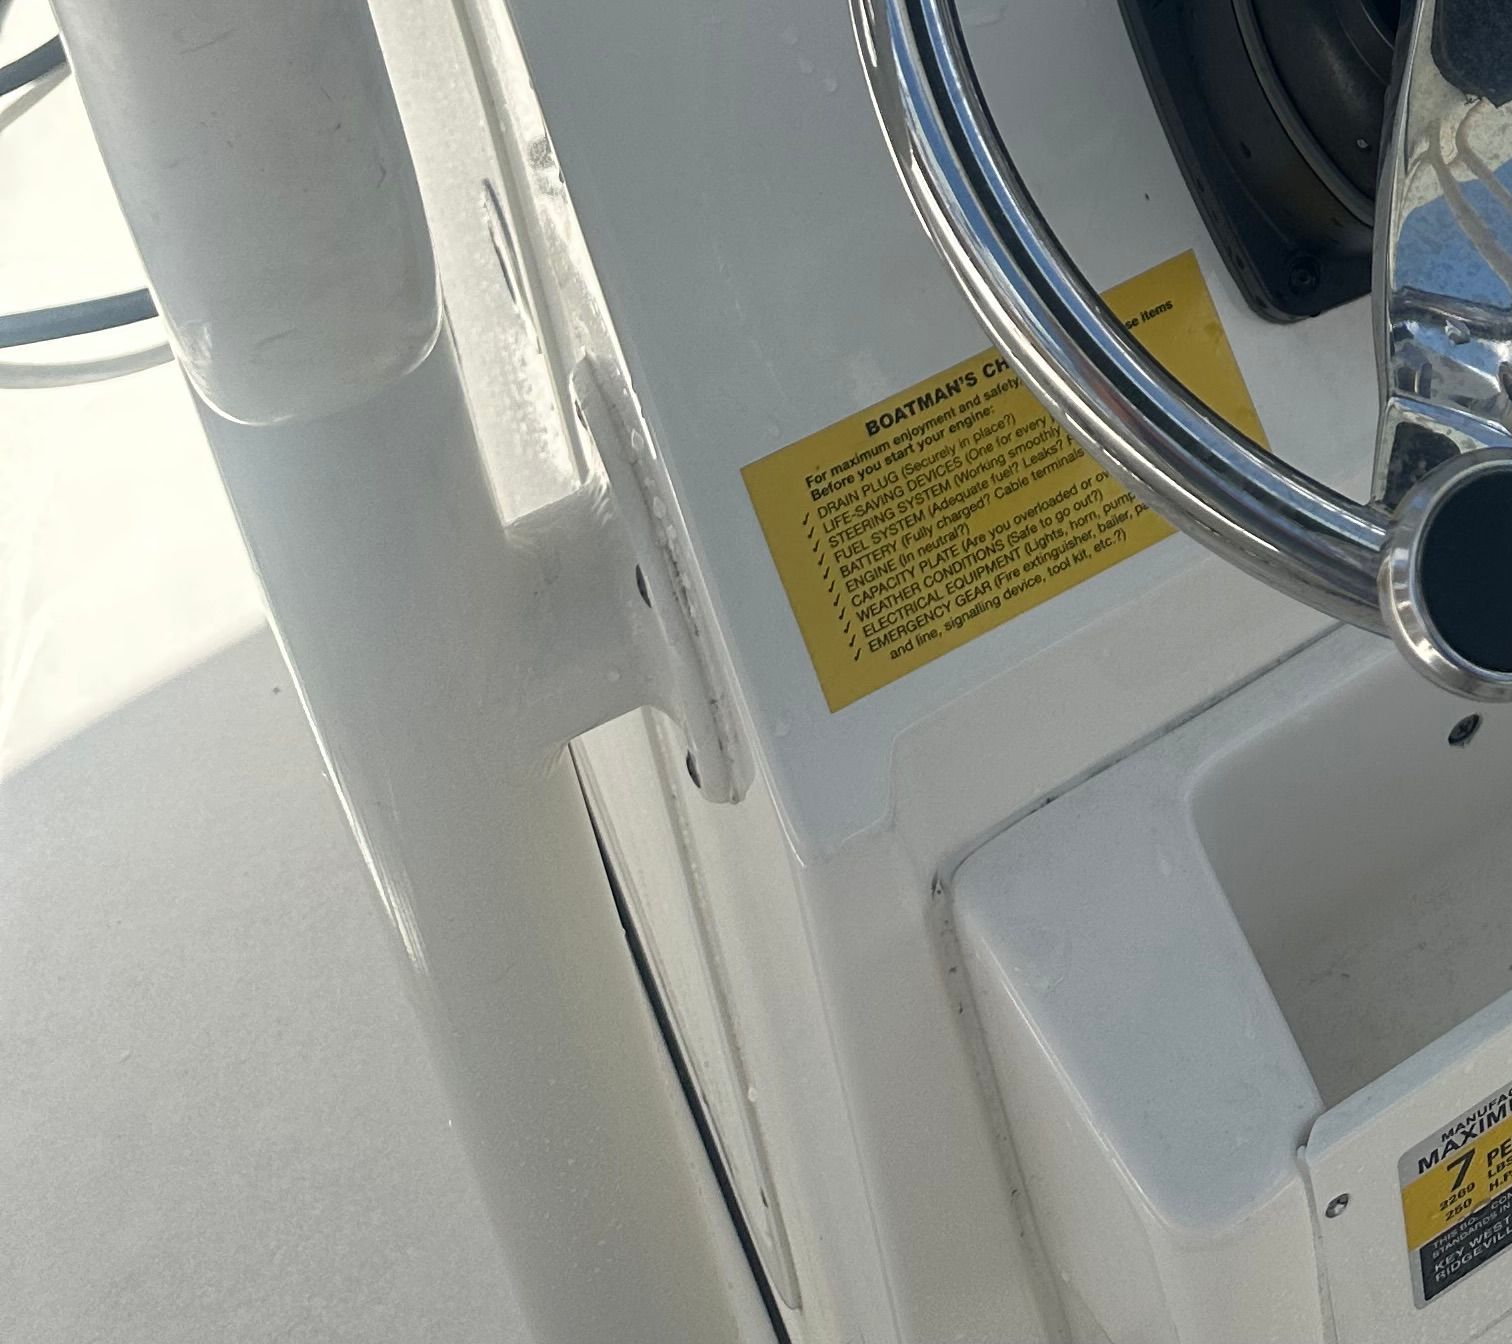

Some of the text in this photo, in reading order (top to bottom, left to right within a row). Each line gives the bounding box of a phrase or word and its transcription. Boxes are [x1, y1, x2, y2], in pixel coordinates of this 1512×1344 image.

[804, 470, 826, 488] For
[829, 440, 891, 477] maximum
[891, 406, 957, 445] enjoyment
[957, 393, 981, 414] and
[1139, 300, 1173, 322] items
[864, 371, 978, 436] BOATMAN'S
[809, 404, 994, 502] Before you start your engine:
[816, 412, 1016, 519] DRAIN PLUG (Securely in place?)
[821, 415, 1046, 534] LIFE-SAVING DEVICES (One for every
[827, 506, 896, 549] STEERING
[896, 478, 952, 514] SYSTEM
[952, 453, 1007, 488] (Working
[833, 438, 1063, 563] FUEL SYSTEM (Adequate fuel? Leaks?
[838, 447, 1085, 578] BATTERY (Fully charged? Cable terminals
[844, 521, 970, 593] ENGINE (In neutral?)
[850, 566, 915, 607] CAPACITY
[917, 543, 960, 573] PLATE
[960, 533, 986, 553] (Are
[987, 519, 1011, 541] you
[1012, 483, 1079, 526] overloaded
[1079, 477, 1092, 490] or
[855, 487, 1104, 623] WEATHER CONDITIONS (Safe to go out?)
[861, 588, 944, 638] ELECTRICAL
[944, 546, 1021, 595] EQUIPMENT
[866, 600, 951, 653] EMERGENCY
[954, 579, 993, 607] GEAR
[993, 567, 1021, 590] (Fire
[1021, 528, 1096, 573] extinguisher,
[889, 637, 914, 660] and
[914, 628, 942, 647] line,
[942, 595, 1002, 631] signalling
[1001, 573, 1046, 600] device,
[1046, 556, 1071, 577] tool
[1445, 1197, 1472, 1221] 250
[1446, 1147, 1475, 1193] 7
